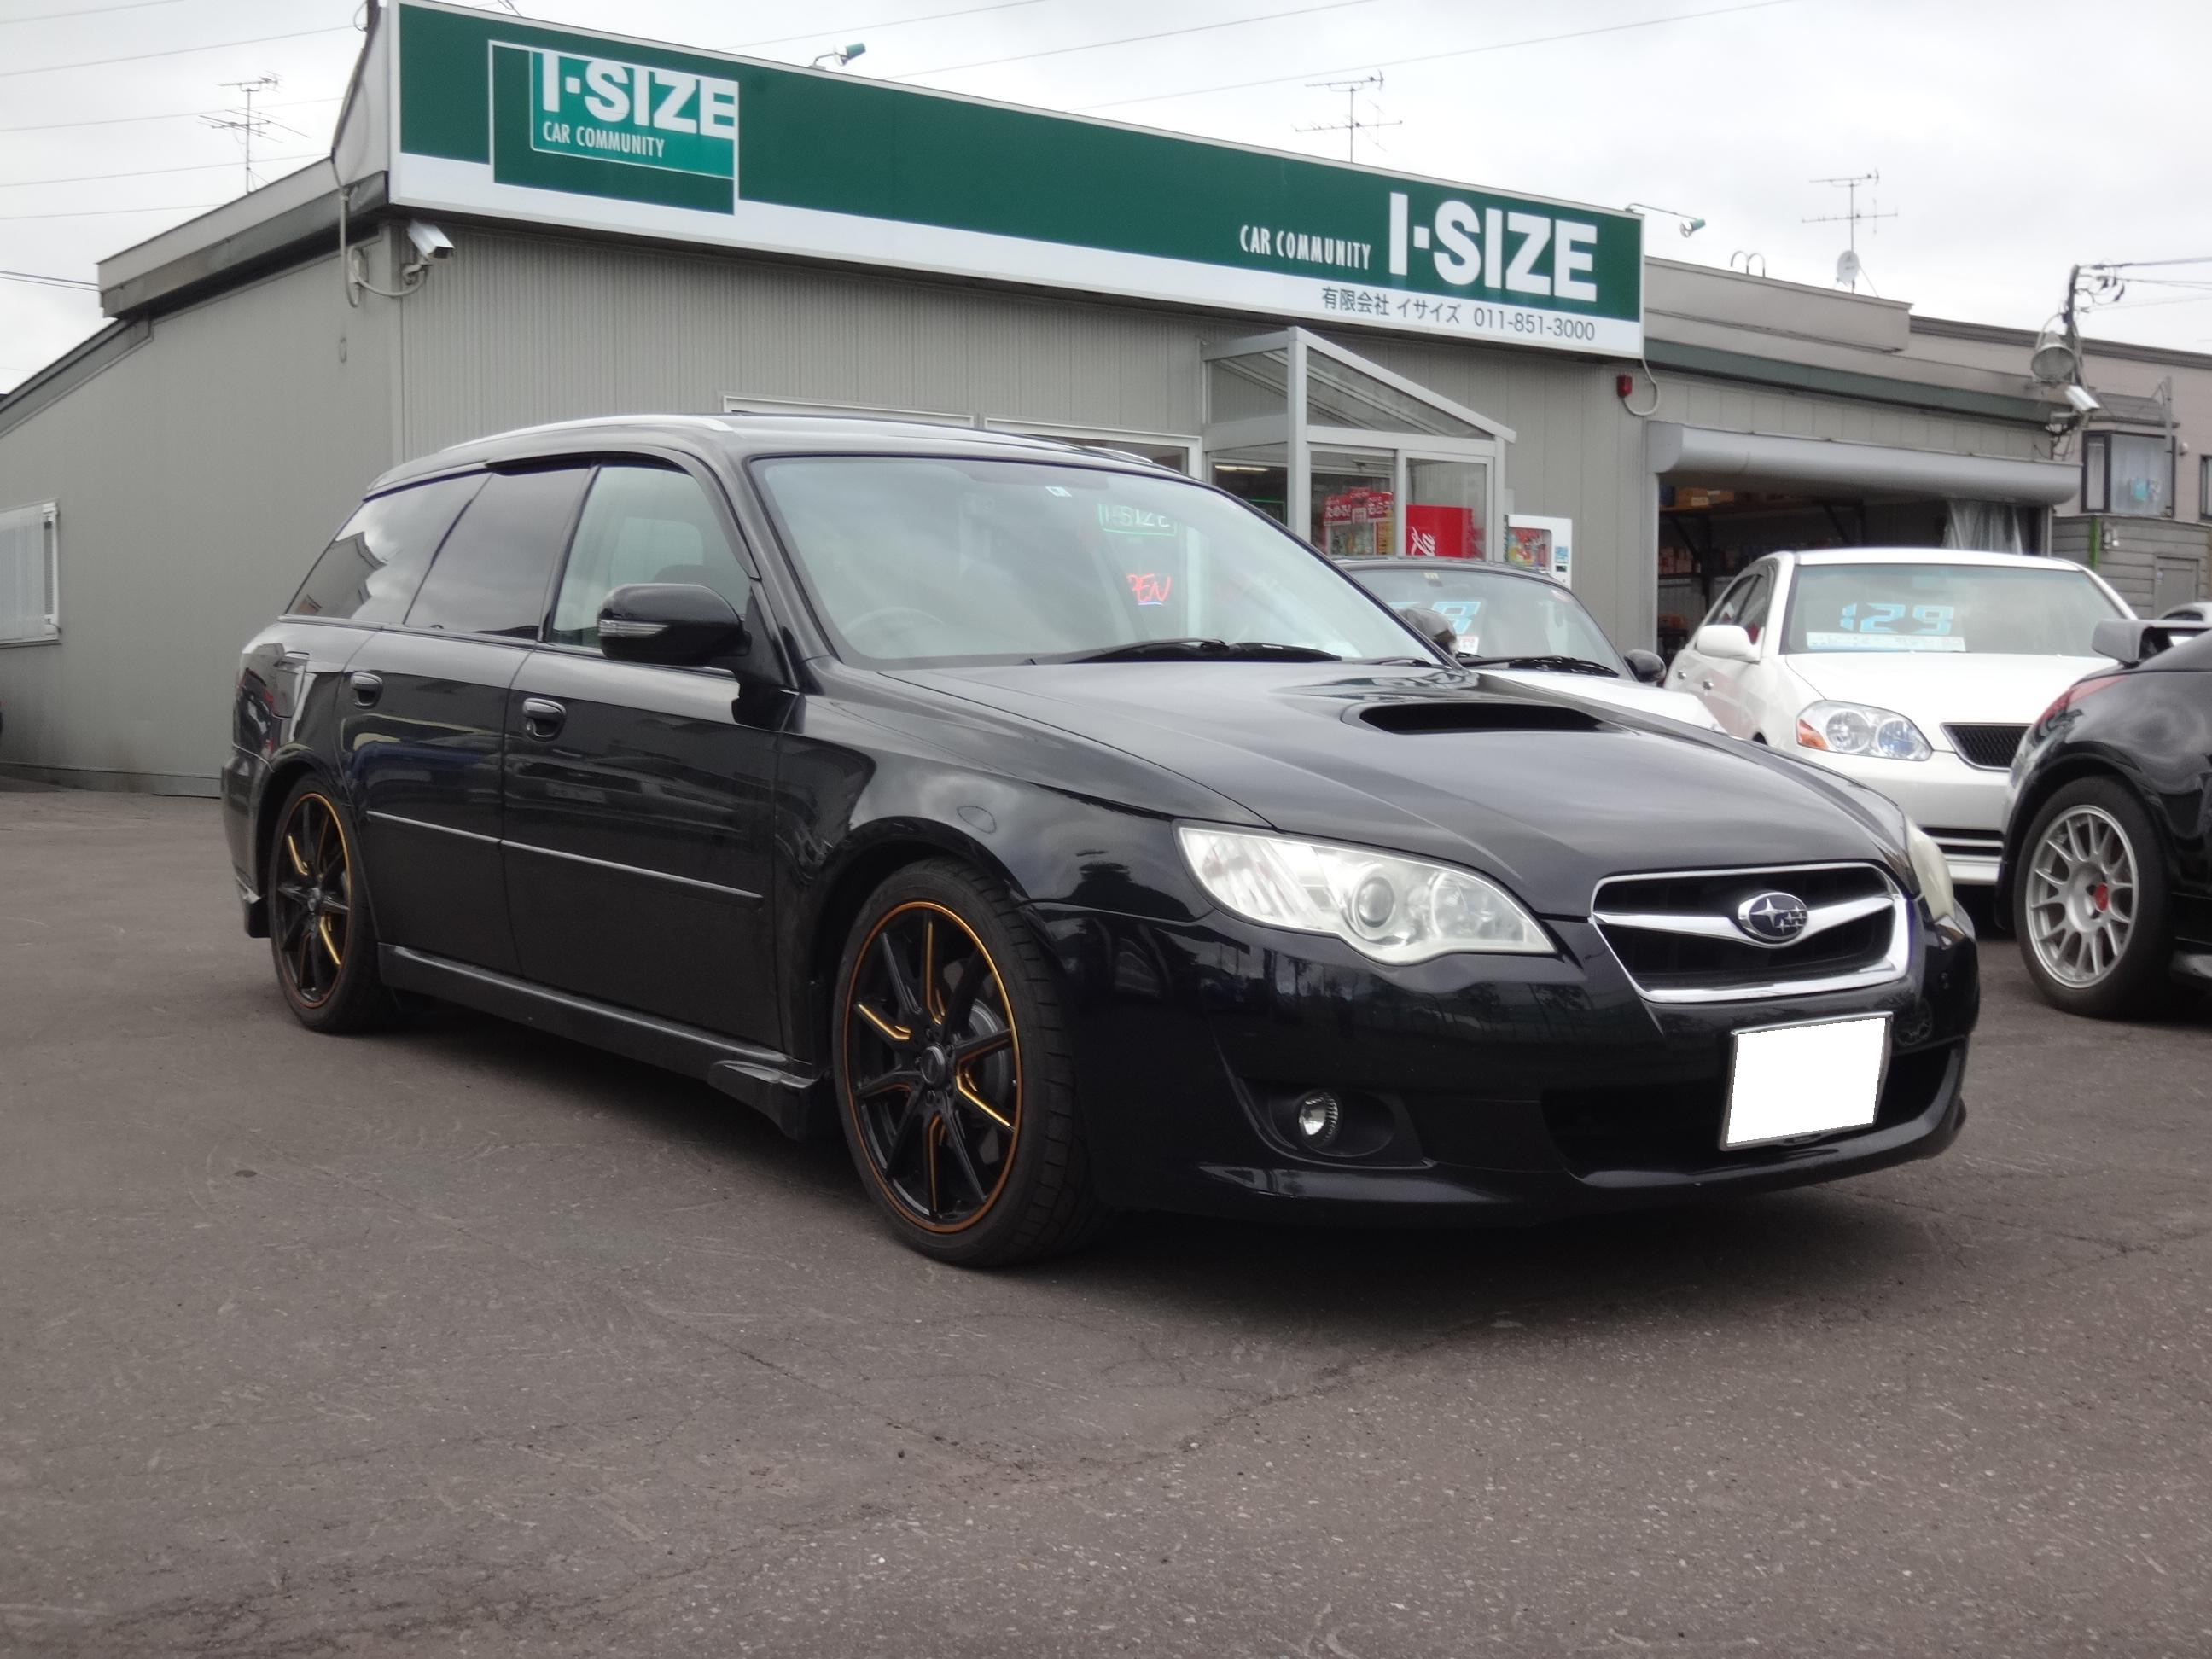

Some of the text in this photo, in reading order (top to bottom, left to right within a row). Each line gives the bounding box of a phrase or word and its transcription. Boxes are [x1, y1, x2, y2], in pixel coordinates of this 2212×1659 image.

[542, 121, 666, 158] CAR COMMUNITY
[1240, 224, 1371, 270] CAR COMMUNITY
[1322, 287, 1596, 341] 有限会社 イサイズ 011-851-3000
[1840, 602, 1954, 635] 129
